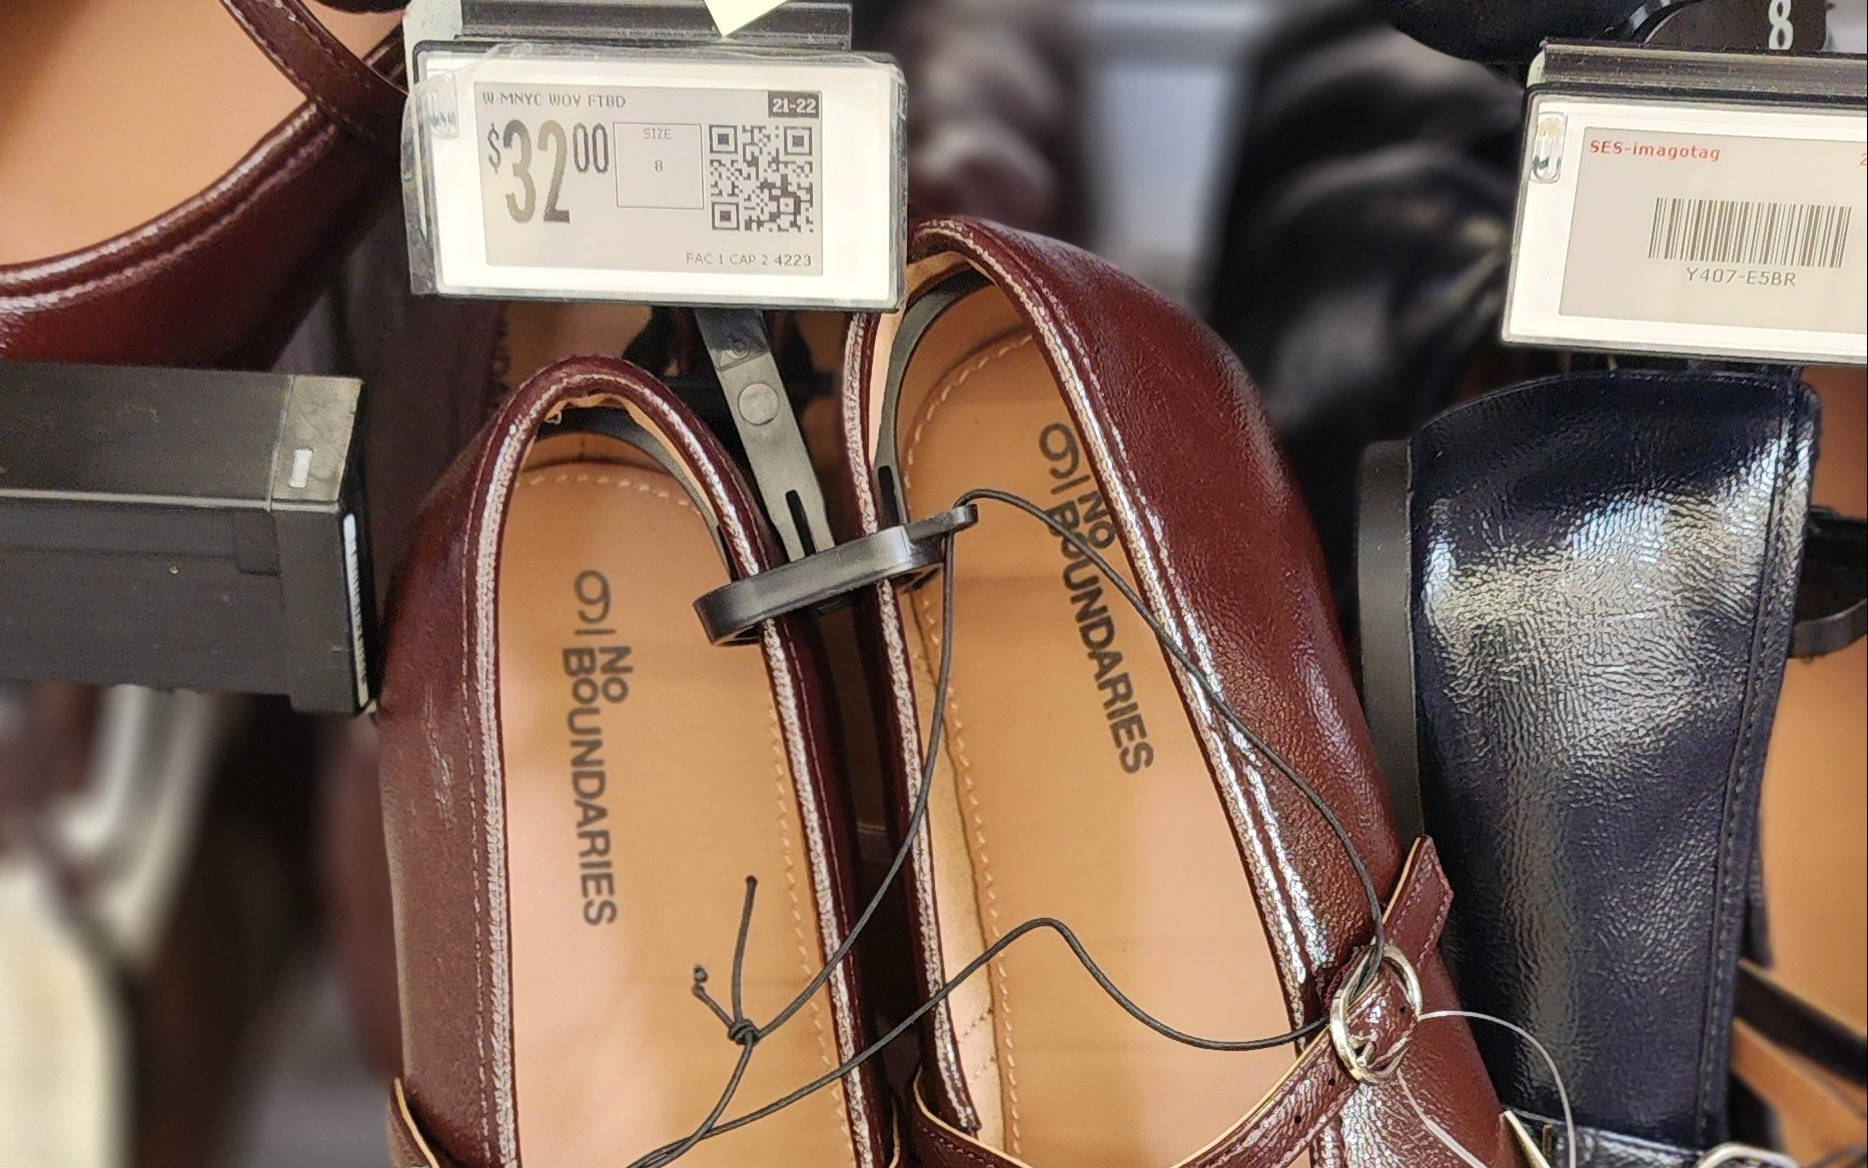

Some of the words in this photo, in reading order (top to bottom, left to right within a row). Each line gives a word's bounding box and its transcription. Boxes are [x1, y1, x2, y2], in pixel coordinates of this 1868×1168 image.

[1768, 0, 1793, 50] 8
[482, 92, 494, 105] W
[500, 92, 542, 106] MNYC
[549, 94, 581, 107] WOV
[588, 95, 626, 108] FTBD
[772, 98, 817, 114] 21-22
[643, 128, 672, 140] SIZE
[1589, 140, 1721, 162] SES-imagotag
[654, 160, 664, 173] 8
[686, 252, 713, 265] FAC
[719, 254, 724, 265] 1
[730, 254, 756, 265] CAP
[762, 254, 768, 266] 2
[774, 254, 812, 267] 4223
[1077, 490, 1116, 549] NO
[1044, 500, 1154, 774] BOUNDARIES
[598, 645, 634, 703] NO
[562, 646, 618, 926] BOUNDARIES
